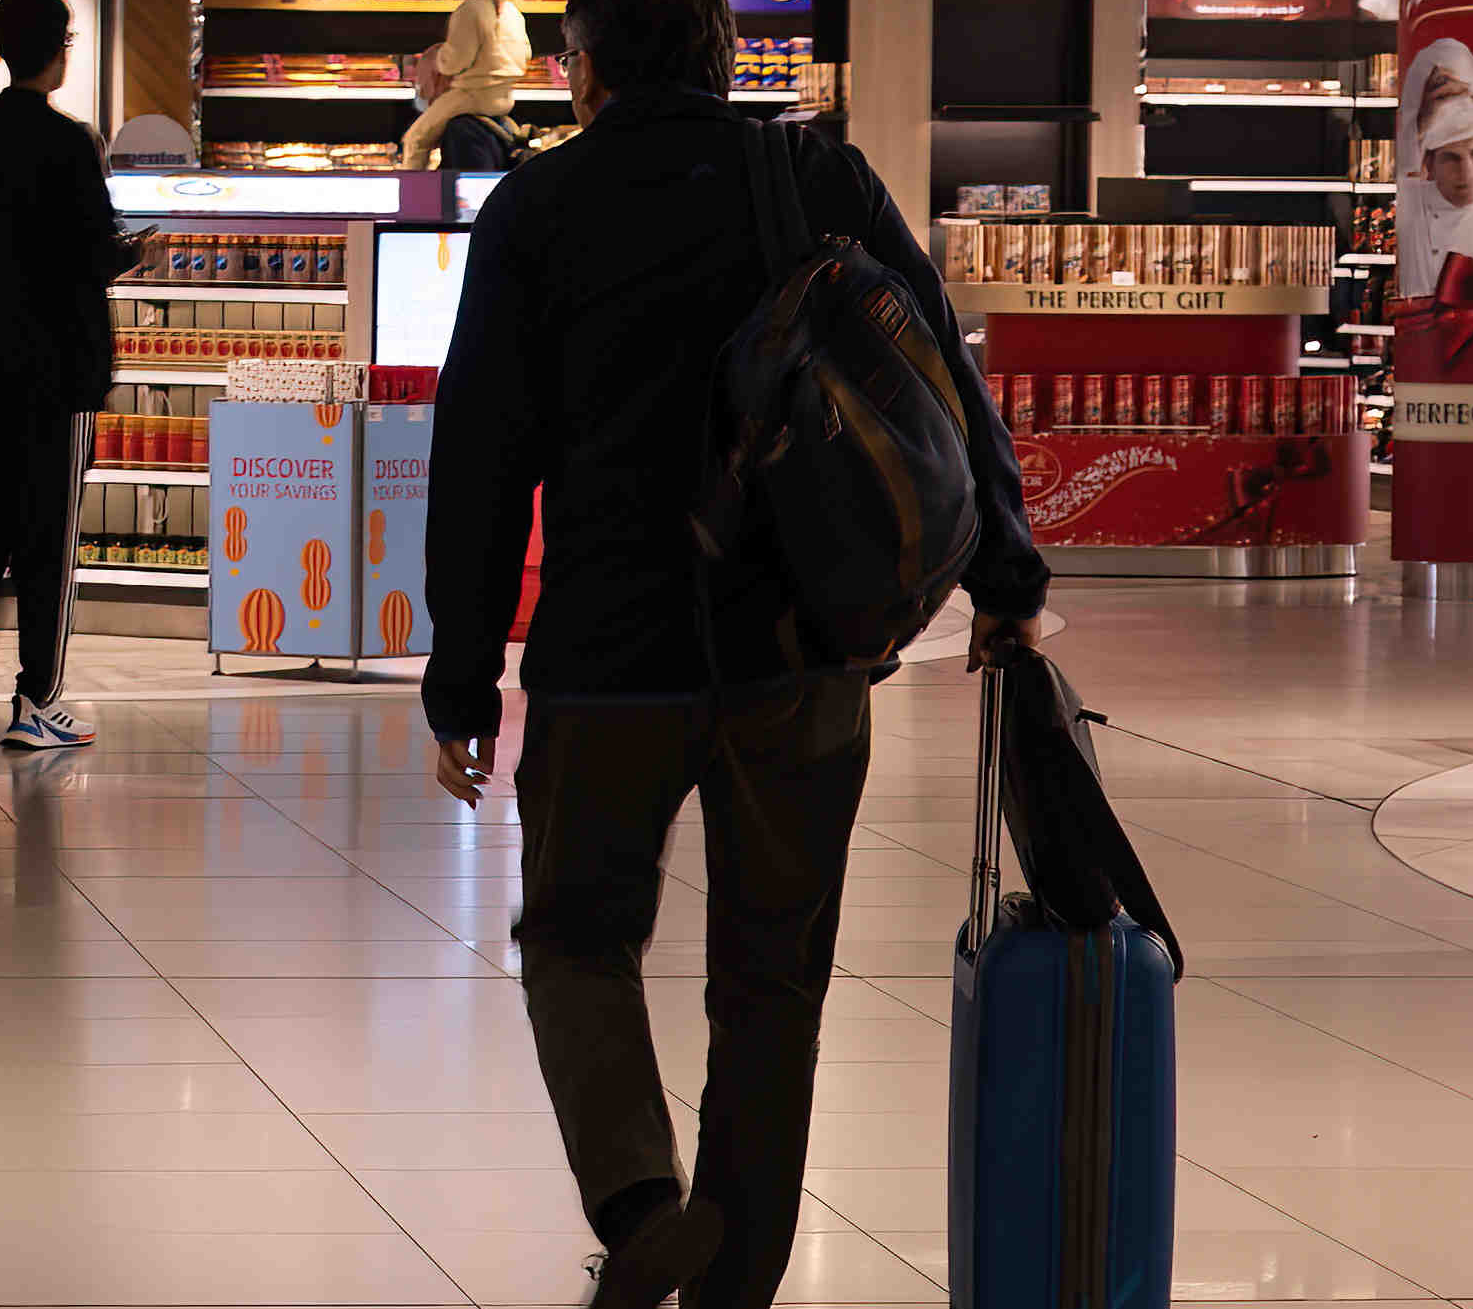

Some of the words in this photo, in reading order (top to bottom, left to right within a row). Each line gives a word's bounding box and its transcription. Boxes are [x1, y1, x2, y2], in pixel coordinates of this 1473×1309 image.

[1025, 290, 1066, 309] THE
[1076, 290, 1169, 310] PERFECT
[1177, 291, 1227, 310] GIFT
[232, 457, 335, 480] DISCOVER
[229, 483, 269, 500] YOUR
[275, 483, 338, 501] SAVINGS
